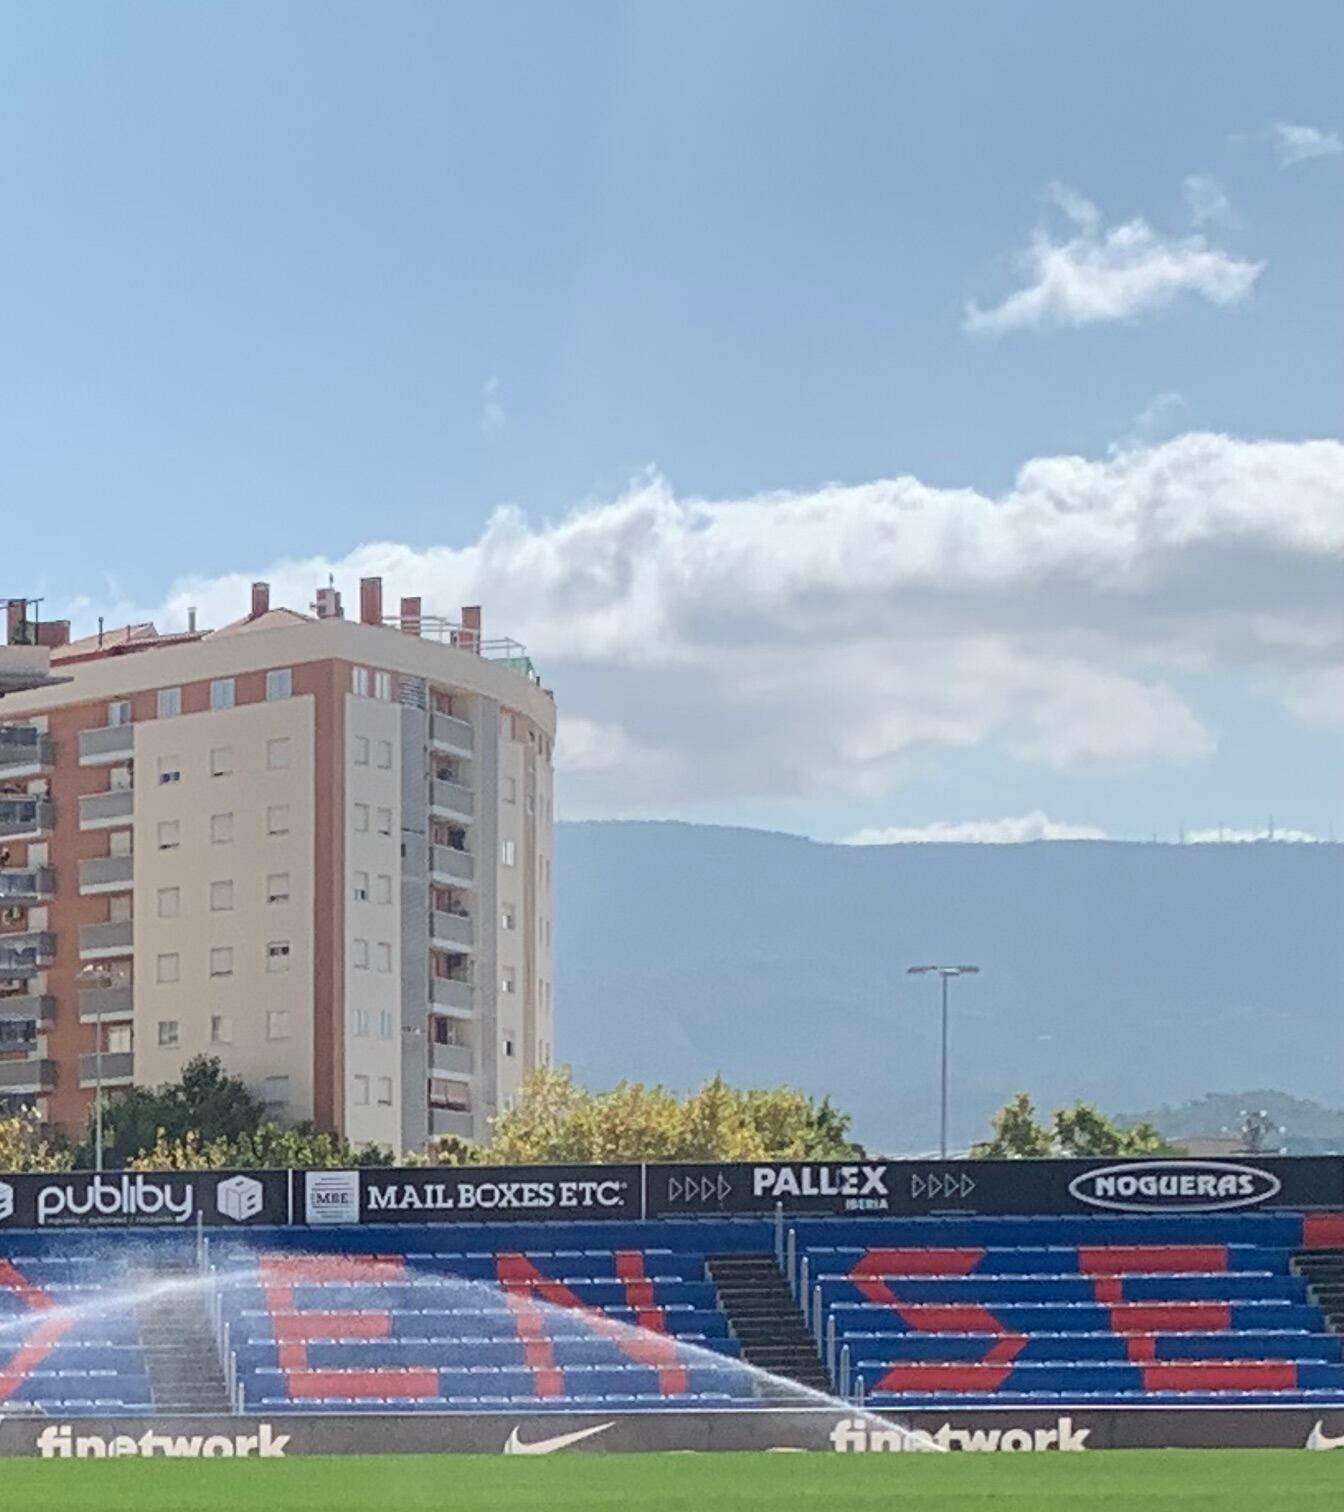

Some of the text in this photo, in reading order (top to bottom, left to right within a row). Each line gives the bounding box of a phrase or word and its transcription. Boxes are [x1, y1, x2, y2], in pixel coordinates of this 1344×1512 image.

[367, 1184, 454, 1209] MAIL
[457, 1183, 554, 1208] BOXES
[753, 1166, 889, 1196] PALLEX
[1094, 1174, 1255, 1198] NOGUERAS
[38, 1175, 193, 1225] publiby
[36, 1424, 291, 1458] finetwork
